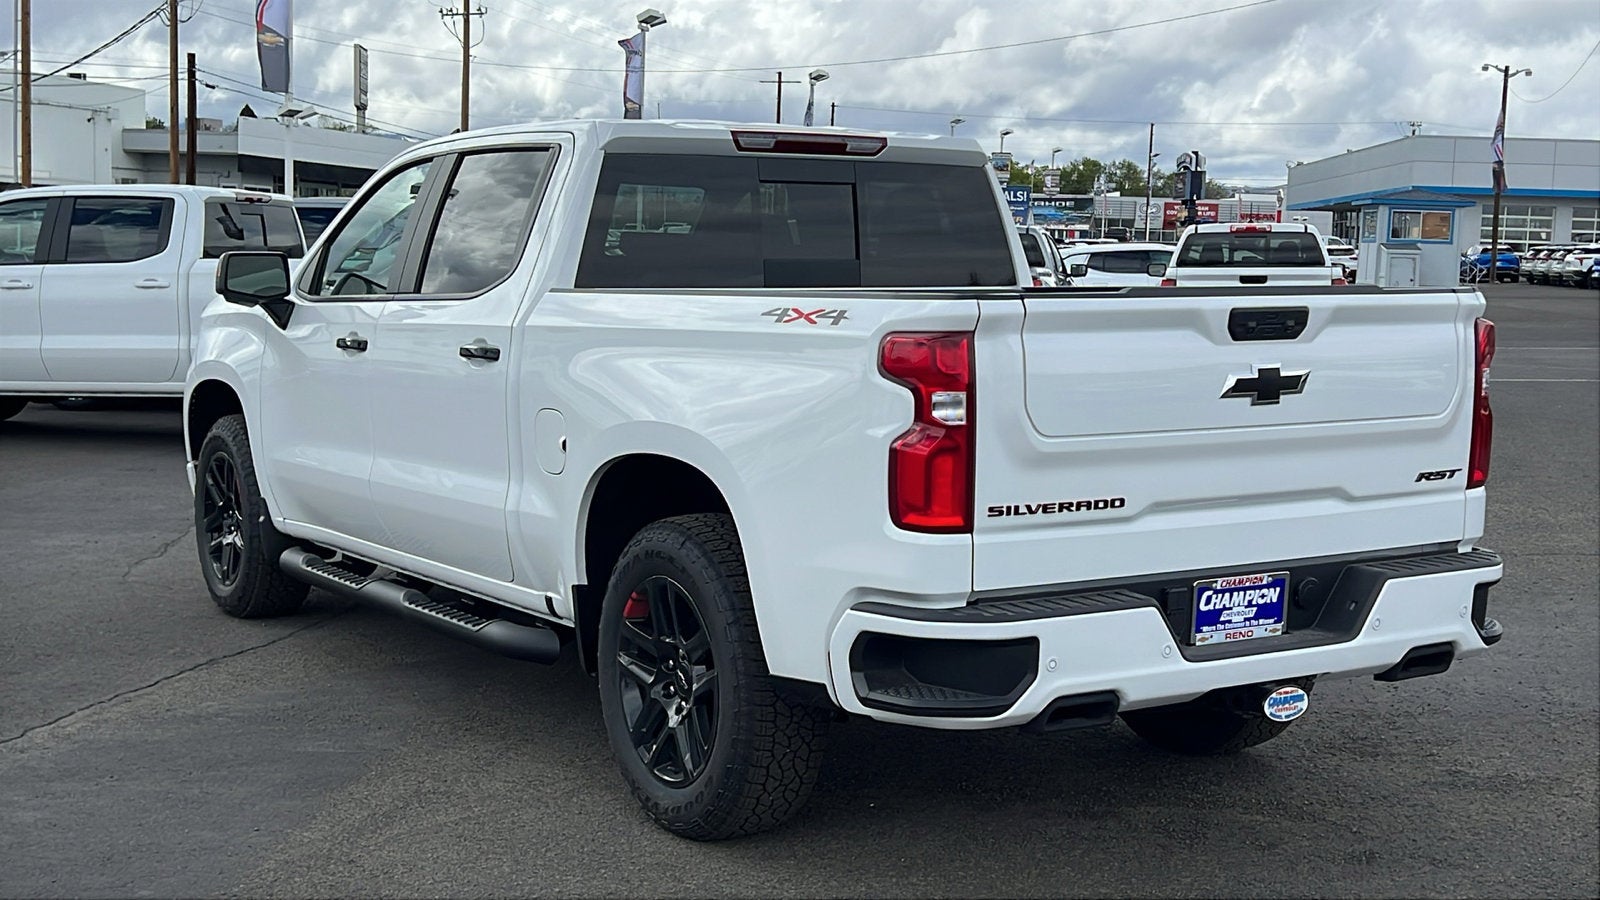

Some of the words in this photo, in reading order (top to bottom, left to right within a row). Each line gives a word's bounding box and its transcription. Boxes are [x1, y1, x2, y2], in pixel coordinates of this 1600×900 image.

[1239, 213, 1276, 221] NISSAN
[1414, 468, 1463, 483] RST
[987, 497, 1126, 518] SILVERADO
[1220, 575, 1264, 588] CHAMPION
[1199, 587, 1281, 612] CHAMPION
[1222, 609, 1255, 619] CHEVROLET
[1224, 630, 1254, 641] RENO
